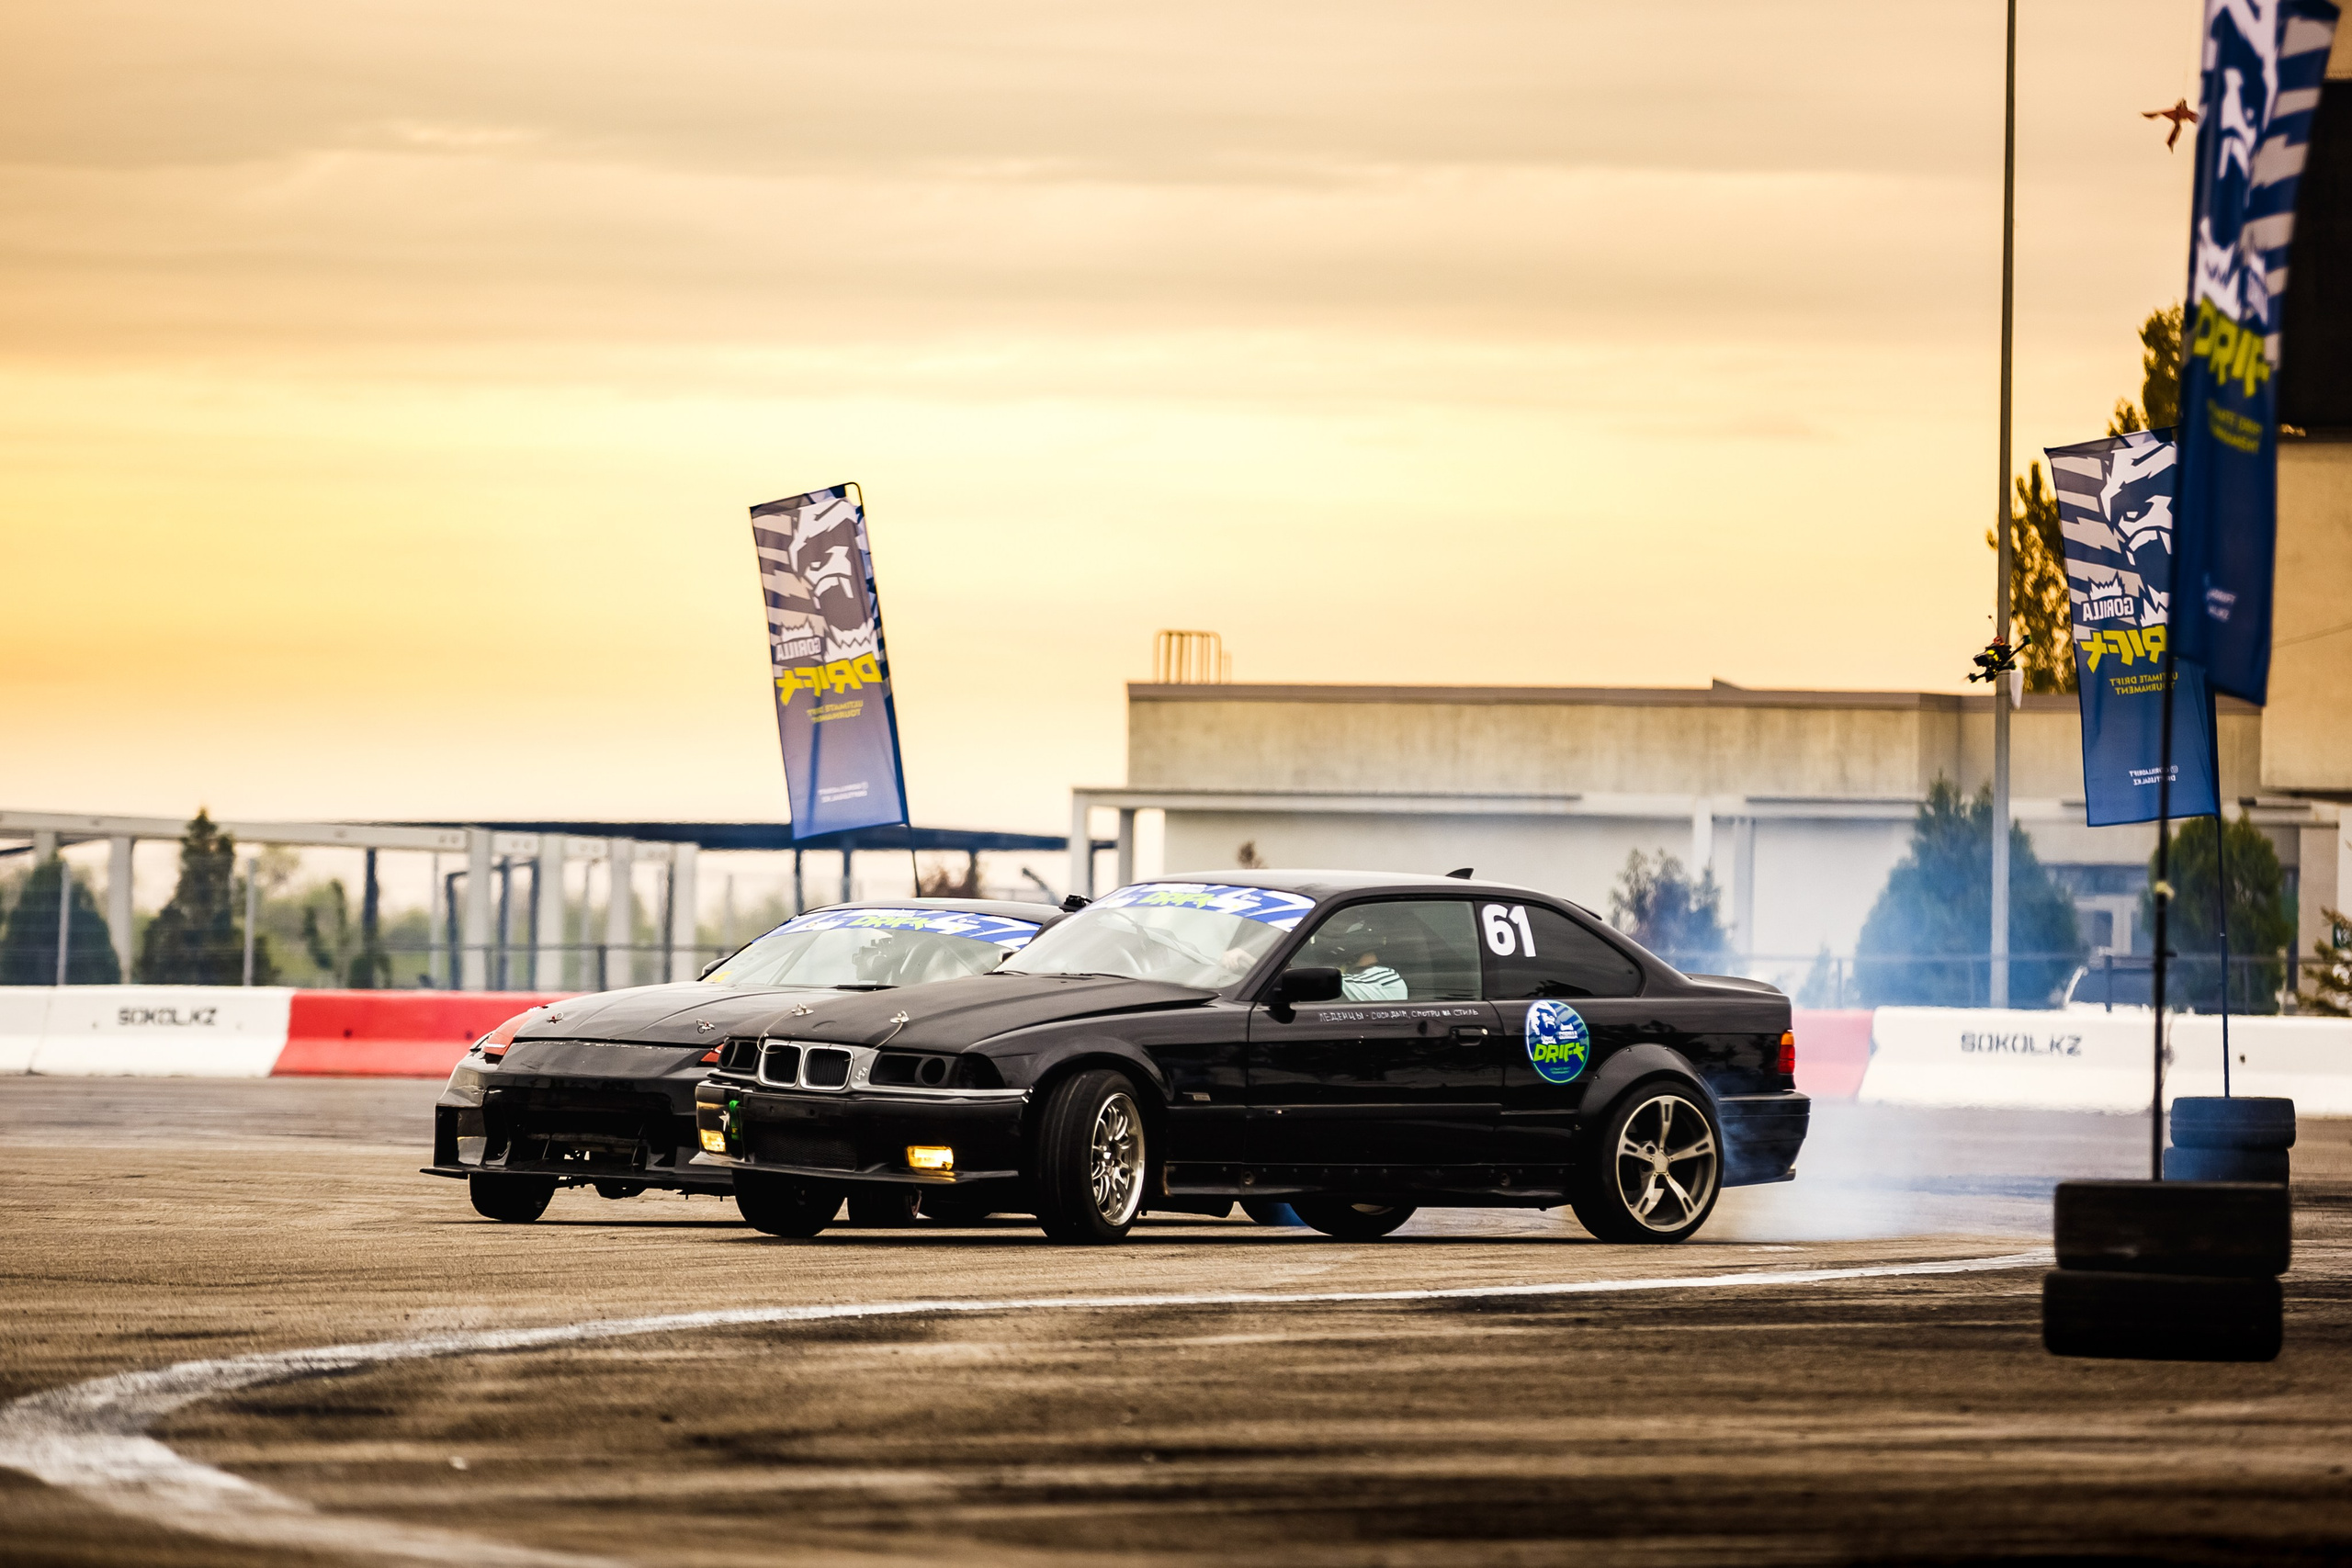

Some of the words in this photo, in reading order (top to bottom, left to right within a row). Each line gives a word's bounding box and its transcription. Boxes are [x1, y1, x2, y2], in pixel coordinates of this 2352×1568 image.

[1138, 891, 1216, 908] DRIFT
[846, 916, 933, 932] DRIFT
[1481, 904, 1536, 957] 61
[1318, 1011, 1364, 1022] ЛЕДЕНЦЫ
[1411, 1010, 1441, 1018] СМОТРИ
[1453, 1009, 1479, 1017] СТИЛЬ
[1532, 1042, 1585, 1063] DRIFT
